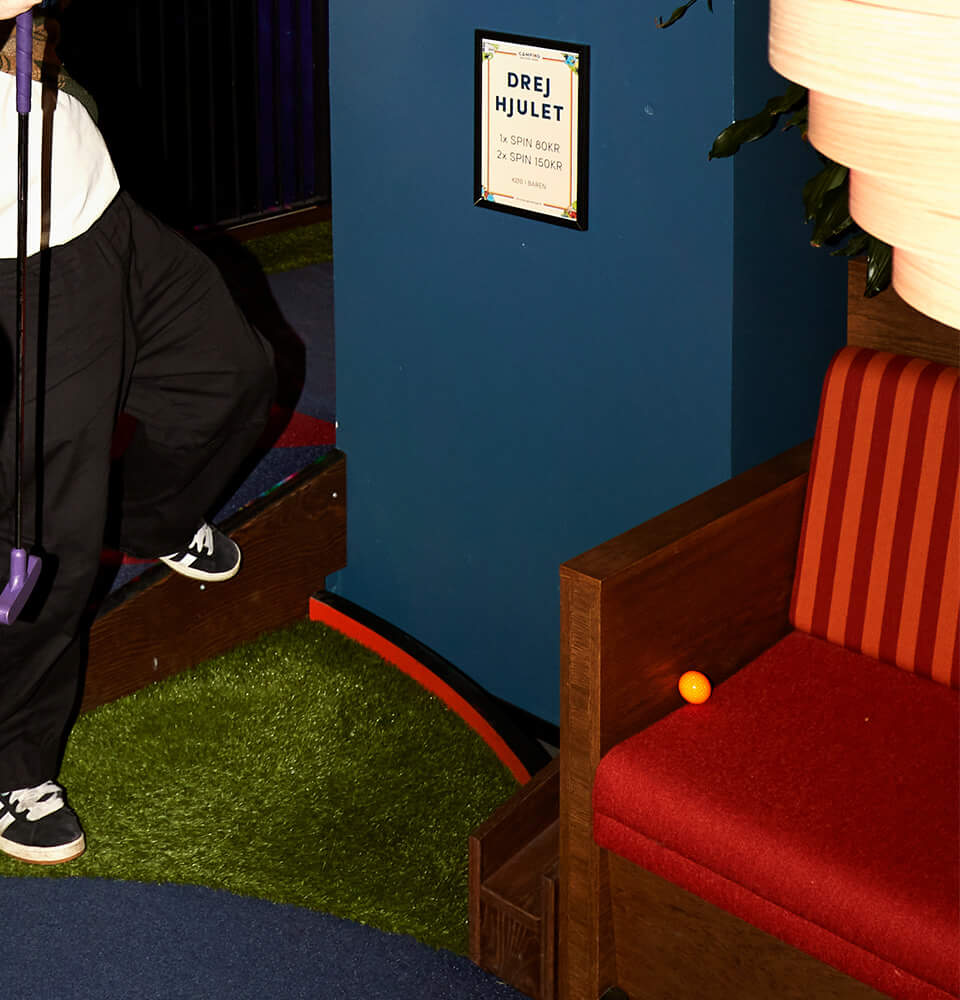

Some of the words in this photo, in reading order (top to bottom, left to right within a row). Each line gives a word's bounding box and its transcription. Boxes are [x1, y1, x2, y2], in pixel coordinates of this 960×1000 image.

[507, 72, 550, 98] DREJ
[496, 96, 564, 121] HJULET
[510, 135, 532, 148] SPIN
[535, 138, 560, 153] 80KR
[510, 152, 532, 165] SPIN
[534, 156, 562, 171] 150KR
